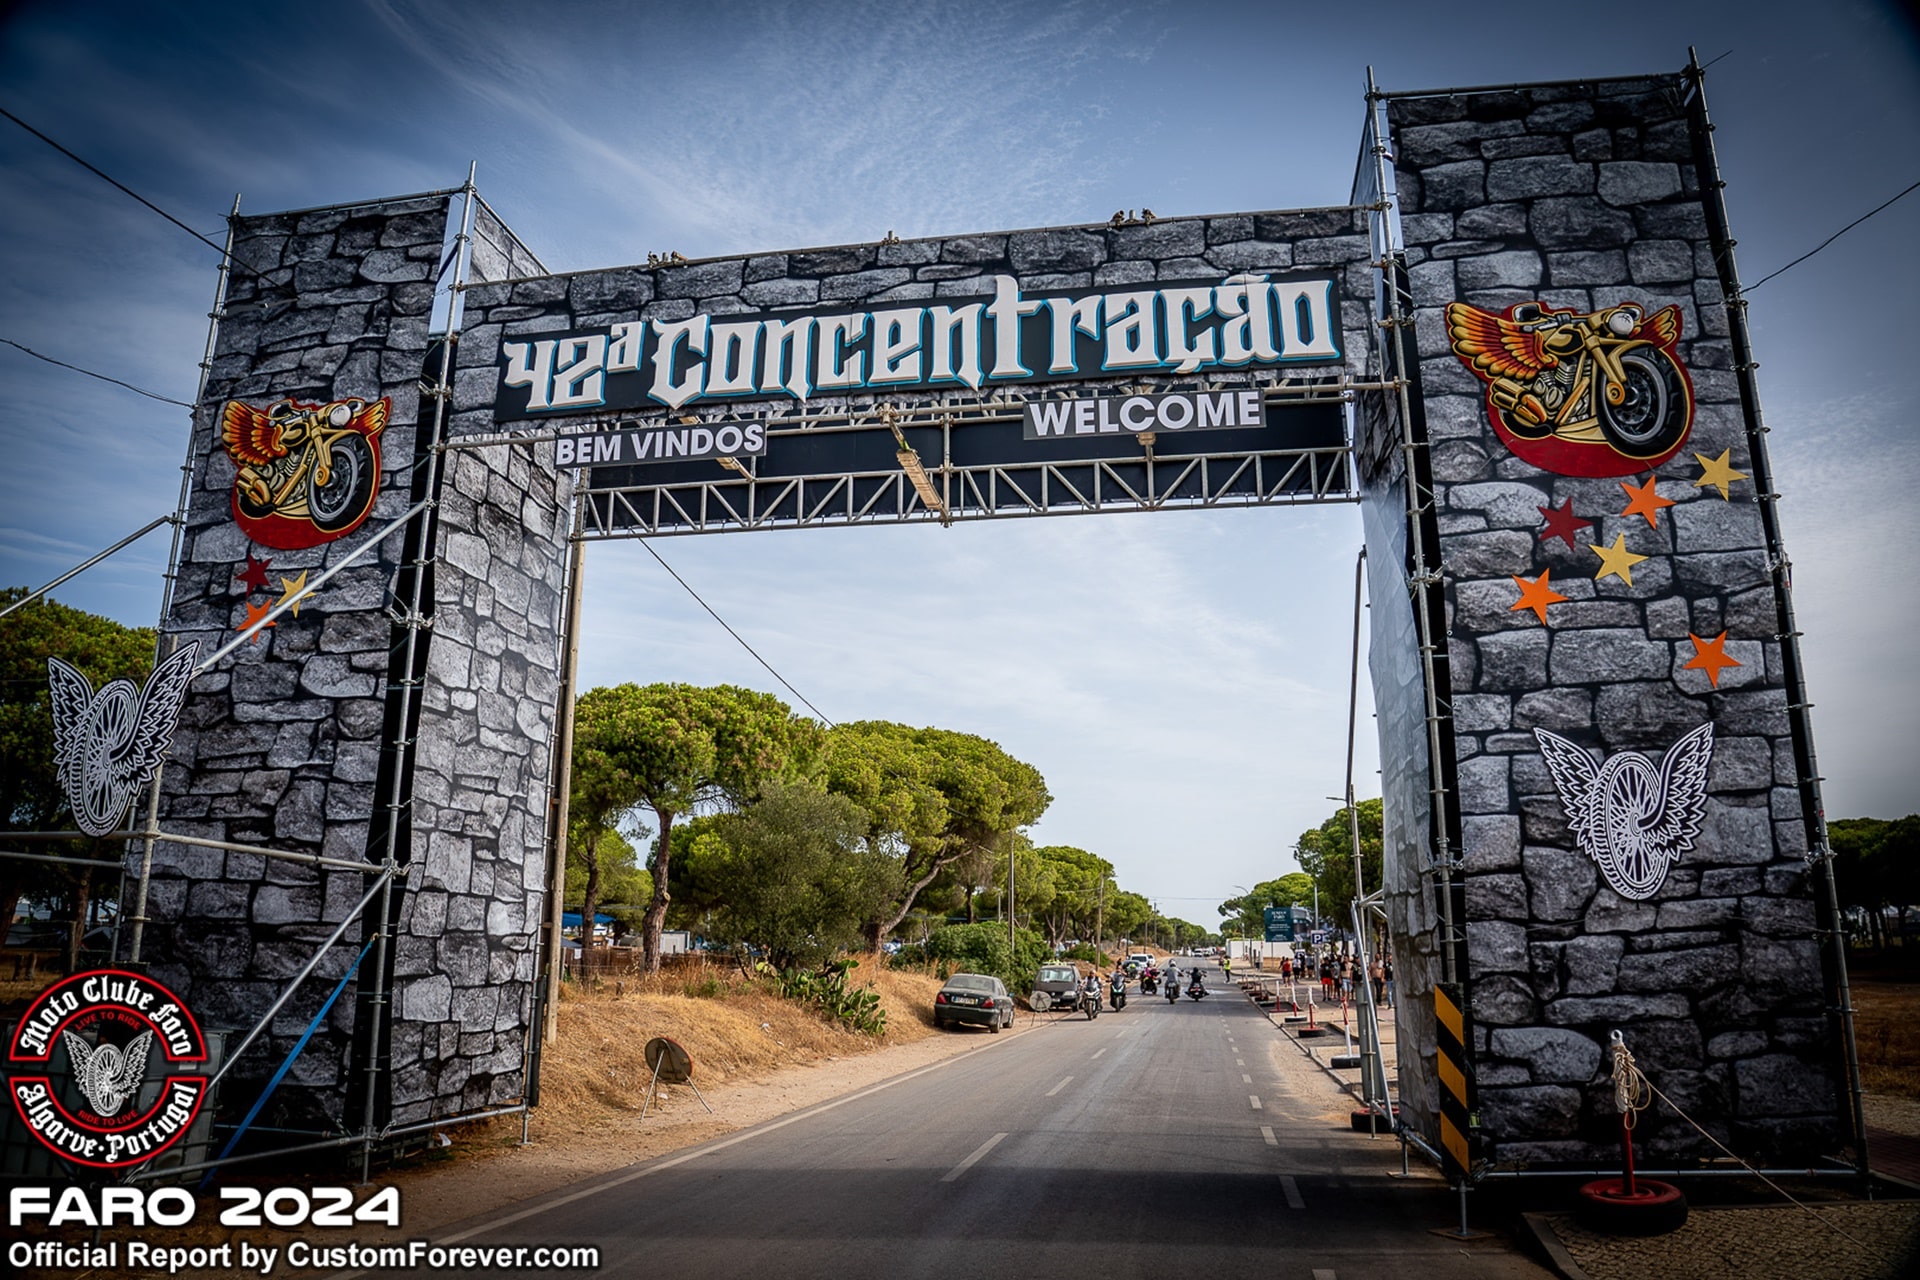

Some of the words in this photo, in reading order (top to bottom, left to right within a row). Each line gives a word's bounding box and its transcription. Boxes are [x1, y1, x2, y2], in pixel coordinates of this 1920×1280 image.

[647, 273, 1340, 411] Concentração
[1029, 391, 1261, 437] WELCOME
[556, 434, 622, 466] BEM
[631, 423, 764, 460] VINDOS
